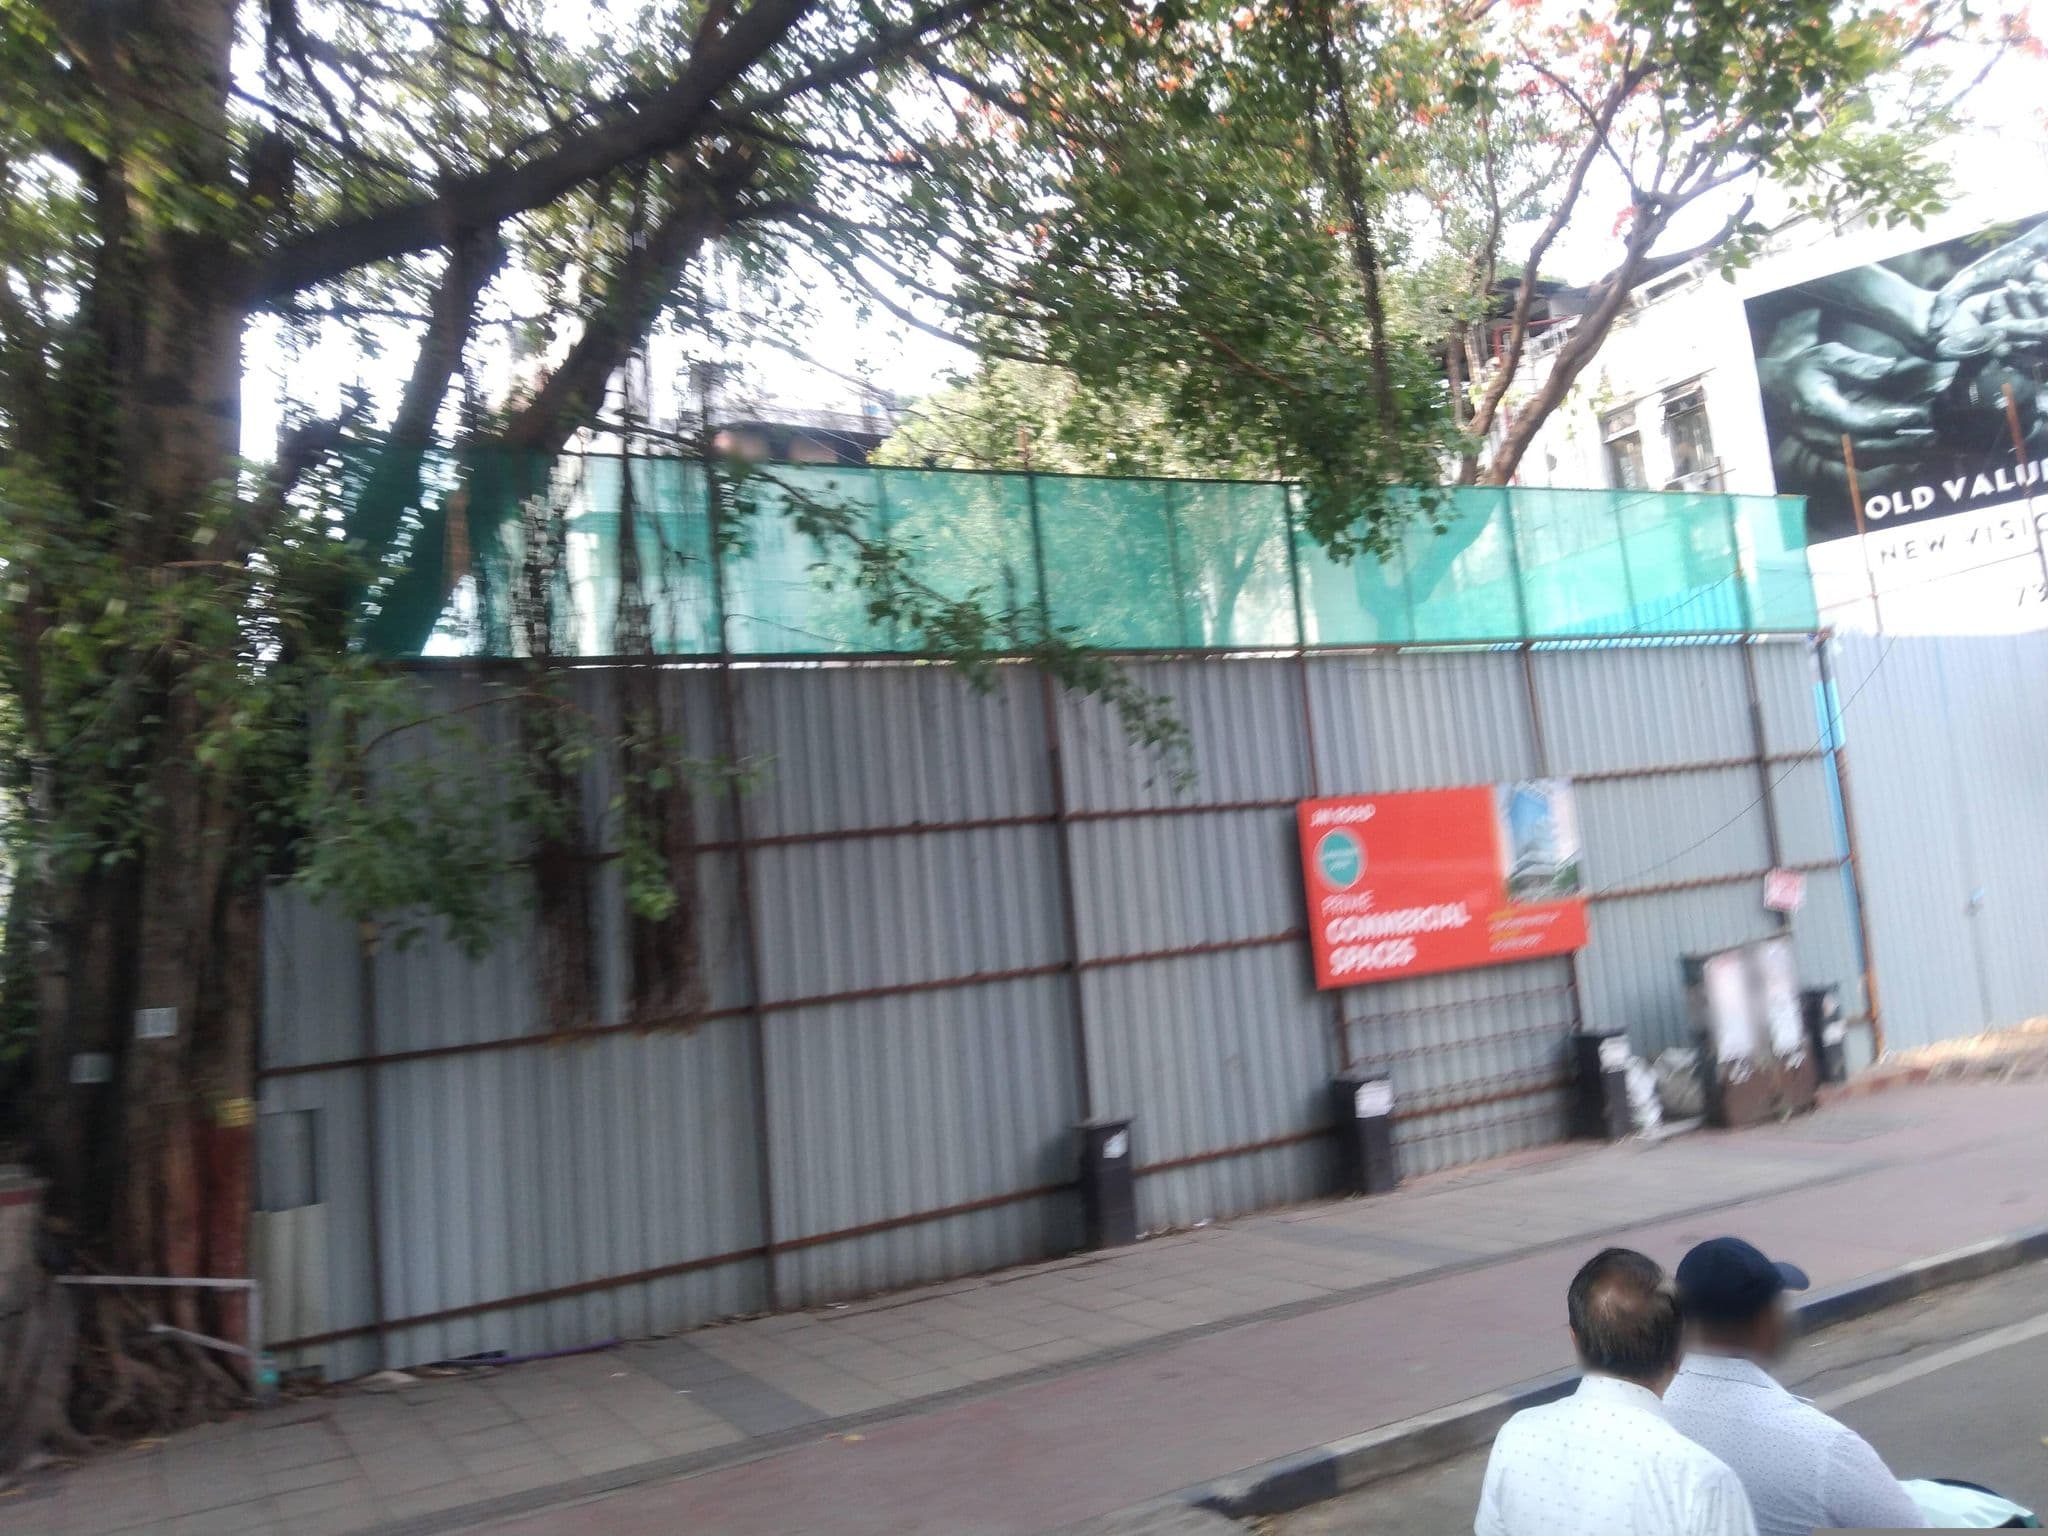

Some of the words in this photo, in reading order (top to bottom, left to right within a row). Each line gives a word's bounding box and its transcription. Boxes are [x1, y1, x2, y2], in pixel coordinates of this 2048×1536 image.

[1864, 485, 1936, 520] OLD
[1880, 533, 1947, 565] NEW
[1325, 901, 1472, 945] COMMERCIAL
[1329, 936, 1418, 976] SPACES
